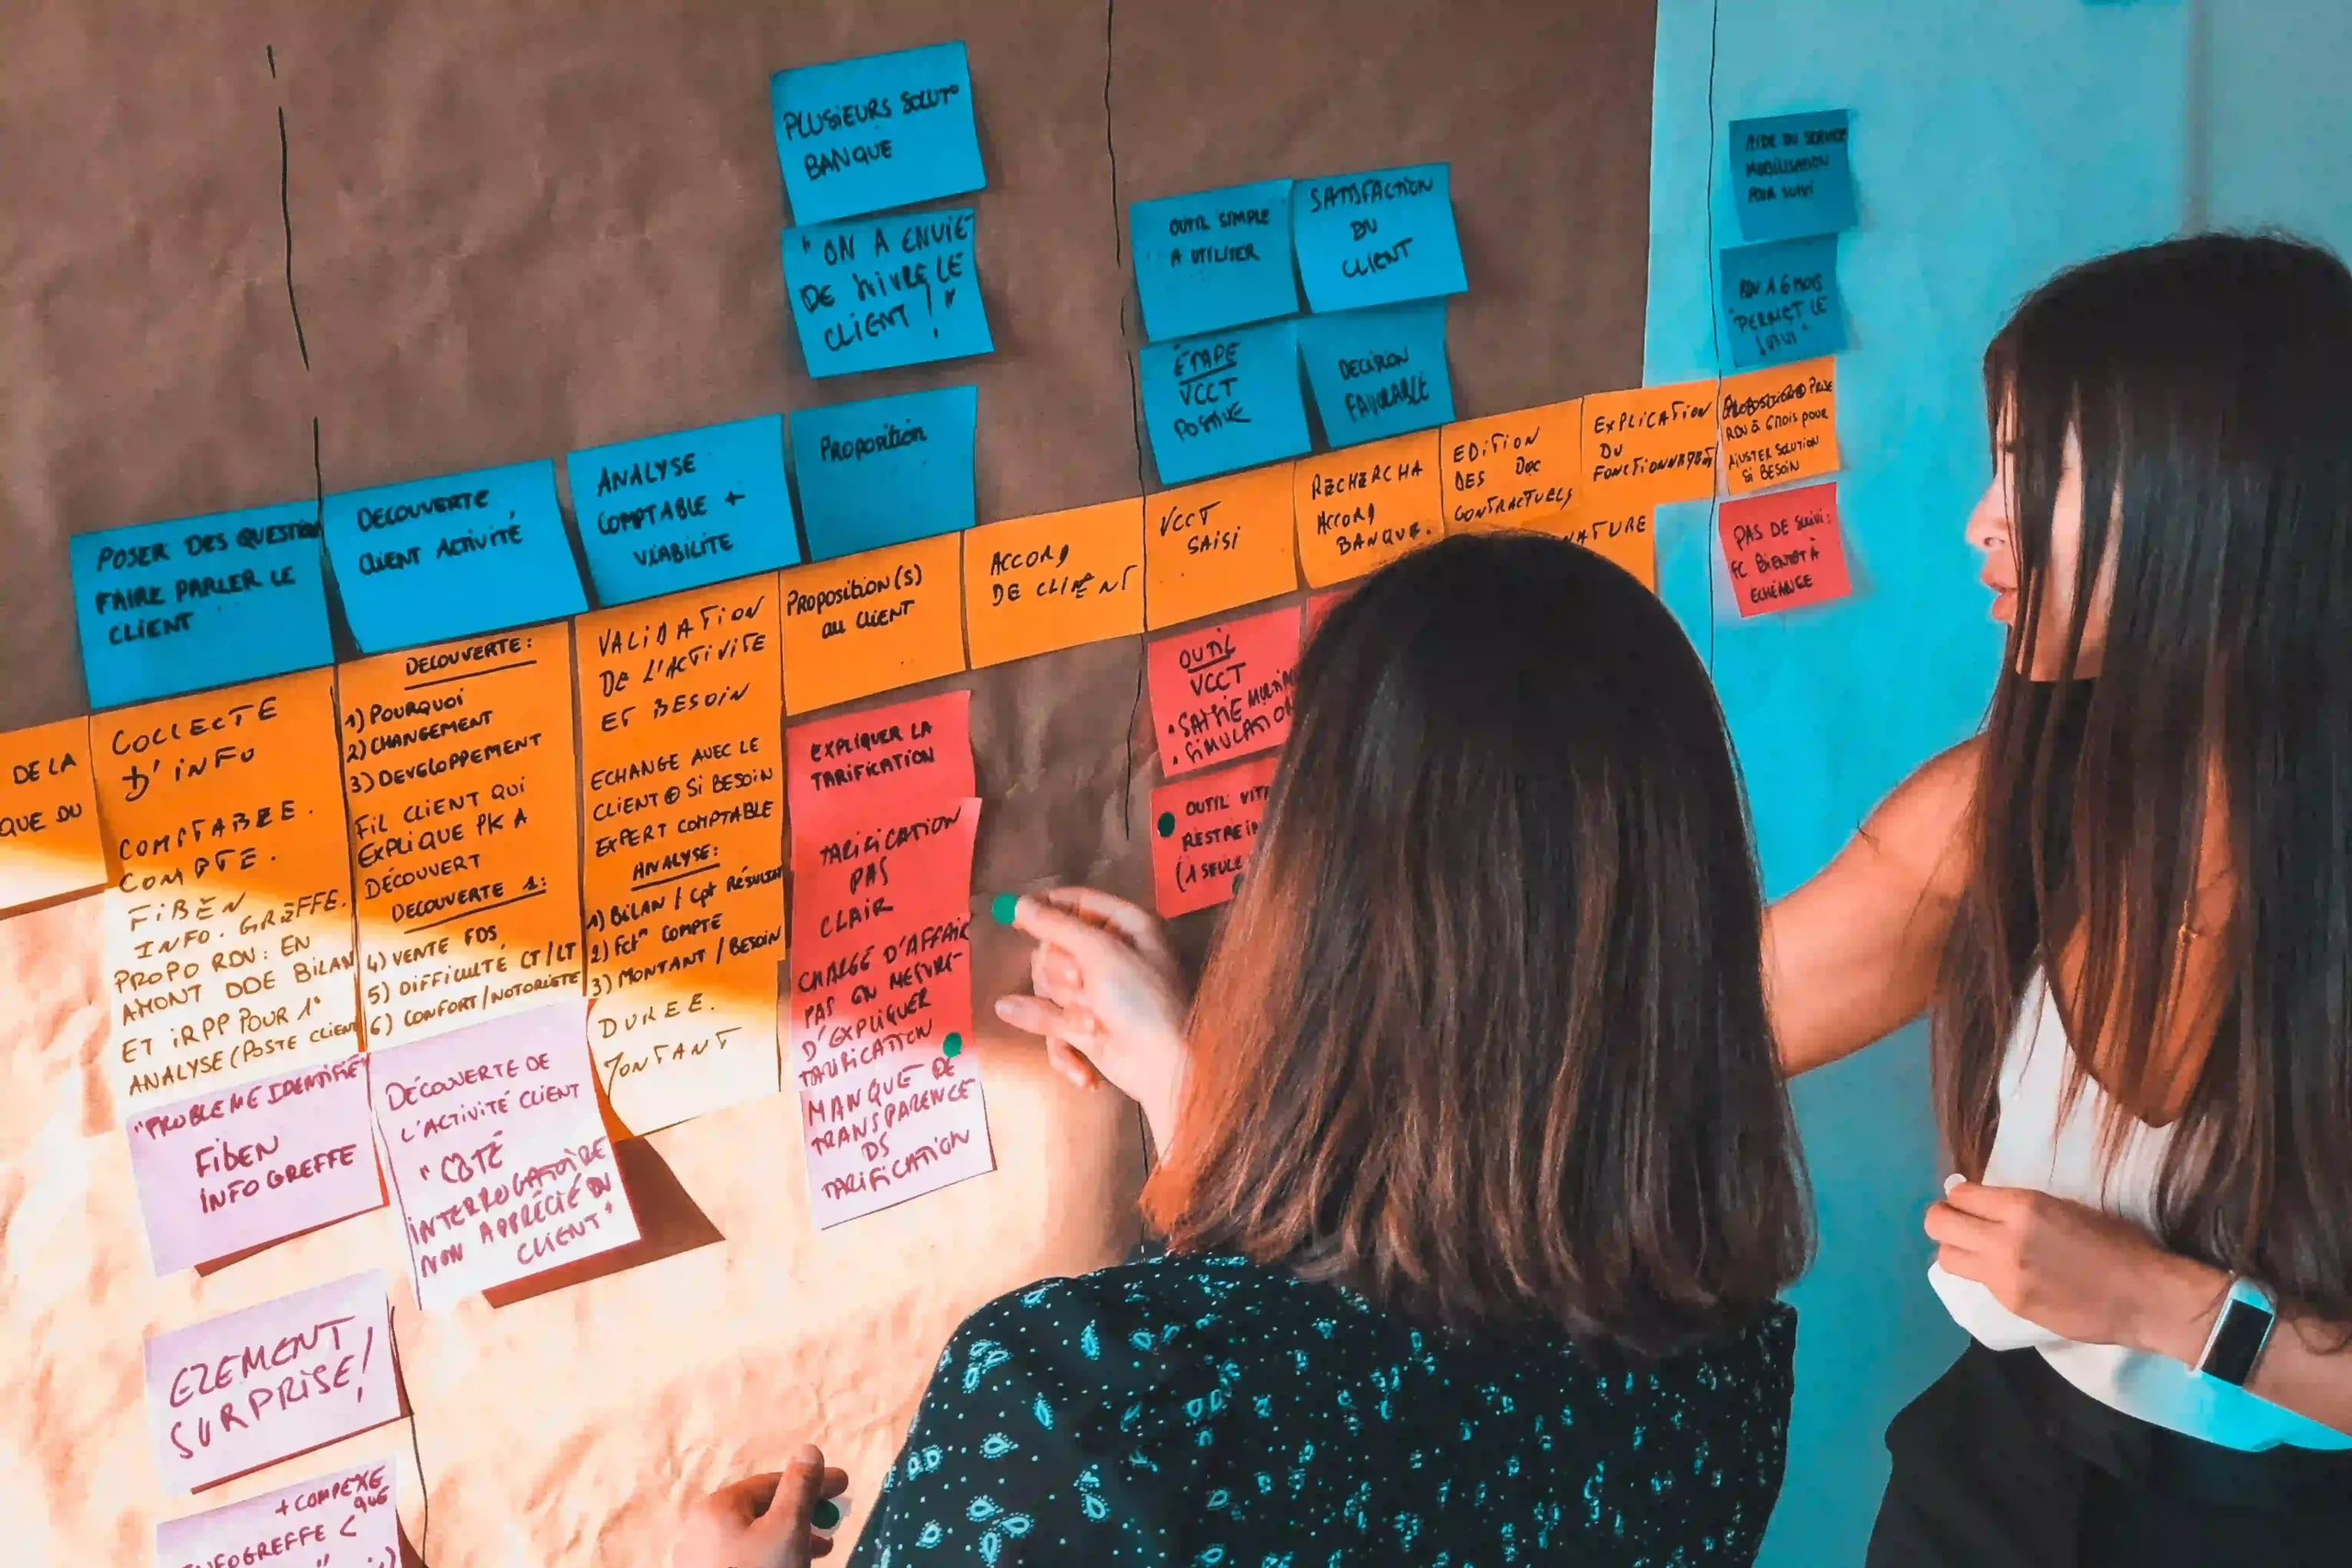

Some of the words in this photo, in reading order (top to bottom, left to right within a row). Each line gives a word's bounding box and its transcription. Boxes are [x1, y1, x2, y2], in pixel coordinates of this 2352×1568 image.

[803, 140, 892, 181] BANQUE
[1218, 208, 1271, 229] SIMPLE
[1351, 218, 1377, 243] DU
[1191, 242, 1261, 265] UTILISER
[799, 284, 835, 313] DE
[937, 253, 963, 283] LE
[1179, 377, 1238, 406] VCCT
[1600, 443, 1623, 459] DU
[597, 453, 696, 497] ANALYSE
[1454, 470, 1486, 491] DES
[356, 489, 489, 533] DECOUVERTE
[597, 494, 708, 536] COMPTABLE
[1159, 501, 1221, 536] VCCT
[96, 542, 169, 572] POSER
[187, 530, 228, 557] DES
[1734, 525, 1763, 551] PAS
[1770, 519, 1789, 537] DE
[96, 584, 165, 615] FAIRE
[175, 568, 262, 600] PARLER
[270, 566, 296, 587] LE
[992, 583, 1021, 606] DE
[1190, 661, 1247, 696] VCCT
[111, 696, 277, 758] COLLECTE
[345, 707, 365, 734] 1)
[346, 739, 367, 763] 2)
[371, 710, 493, 755] CHANGEMENT
[601, 706, 636, 732] ET
[810, 726, 903, 761] EXPLIQUER
[911, 721, 933, 739] LA
[13, 760, 40, 784] DE
[49, 752, 76, 775] LA
[590, 753, 680, 791] ECHANGE
[691, 743, 731, 766] AVEC
[740, 737, 760, 754] LE
[349, 772, 375, 794] 3)
[55, 802, 83, 823] DU
[677, 800, 775, 834] COMPTABLE
[1186, 795, 1229, 817] OUTIL
[850, 855, 888, 895] PAS
[1201, 855, 1243, 880] SEULE
[391, 882, 503, 923] DECOUVERTE
[820, 897, 894, 938] CLAIR
[392, 936, 449, 966] VENTE
[464, 925, 497, 947] FDS
[114, 961, 199, 994] PROPO
[280, 934, 311, 957] EN
[592, 974, 613, 998] 3)
[618, 948, 707, 988] MONTANT
[122, 984, 202, 1026] AMONT
[225, 971, 276, 999] DDE
[367, 980, 390, 1005] 5)
[369, 1012, 392, 1036] 6)
[805, 996, 834, 1029] PAS
[122, 1037, 153, 1064] ET
[239, 1006, 289, 1034] POUR
[129, 1050, 223, 1097] ANALYSE
[526, 1053, 549, 1072] DE
[808, 1064, 924, 1126] MANQUE
[266, 1144, 356, 1190] GREFFE
[421, 1243, 463, 1279] NON
